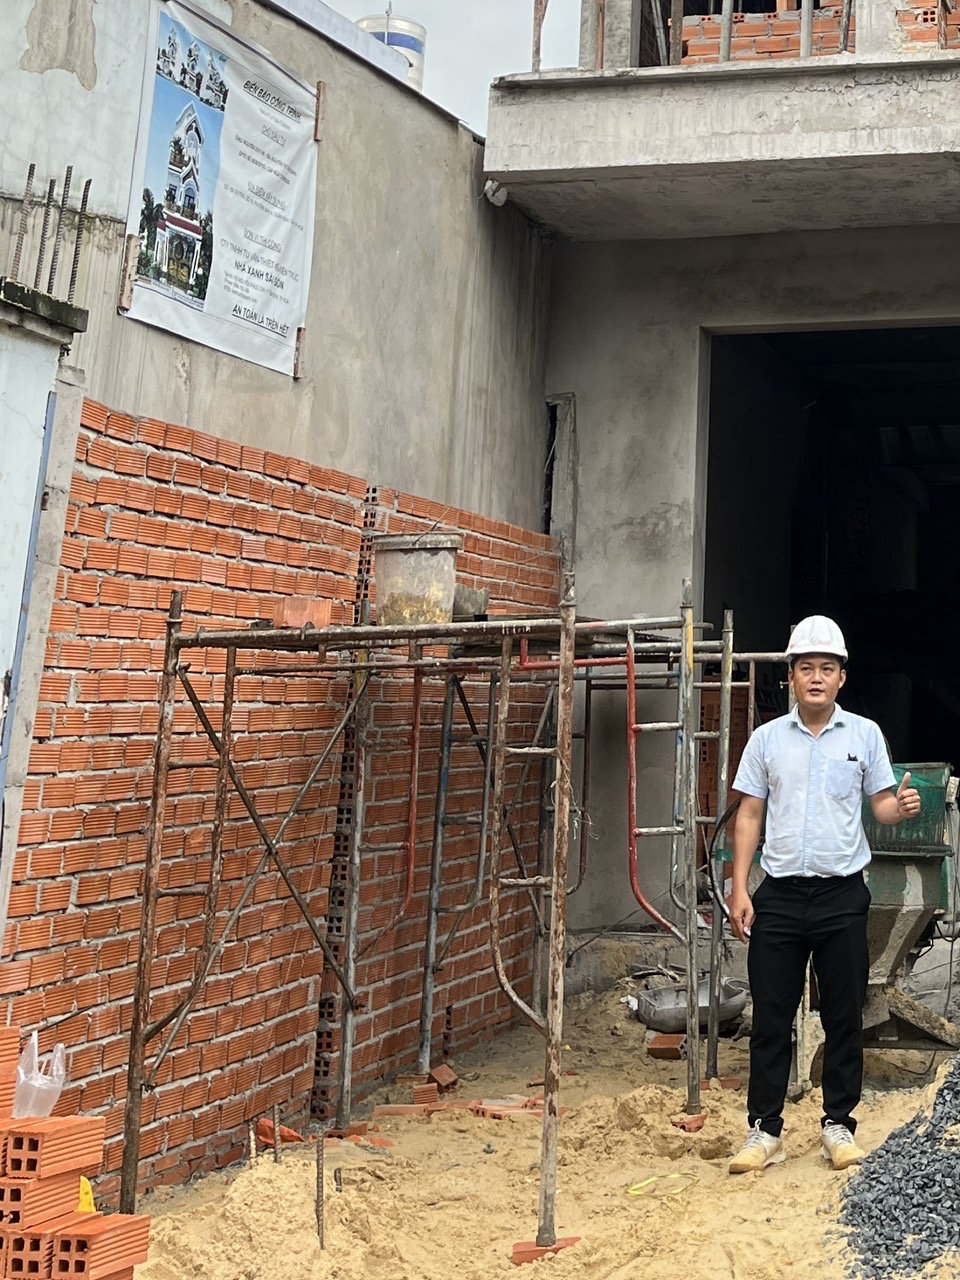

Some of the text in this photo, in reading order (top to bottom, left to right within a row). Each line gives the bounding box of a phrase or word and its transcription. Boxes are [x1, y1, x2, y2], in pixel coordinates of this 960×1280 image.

[257, 89, 271, 102] BÁO
[247, 265, 264, 280] XANH
[232, 304, 242, 315] AN
[243, 307, 258, 322] TOÀN
